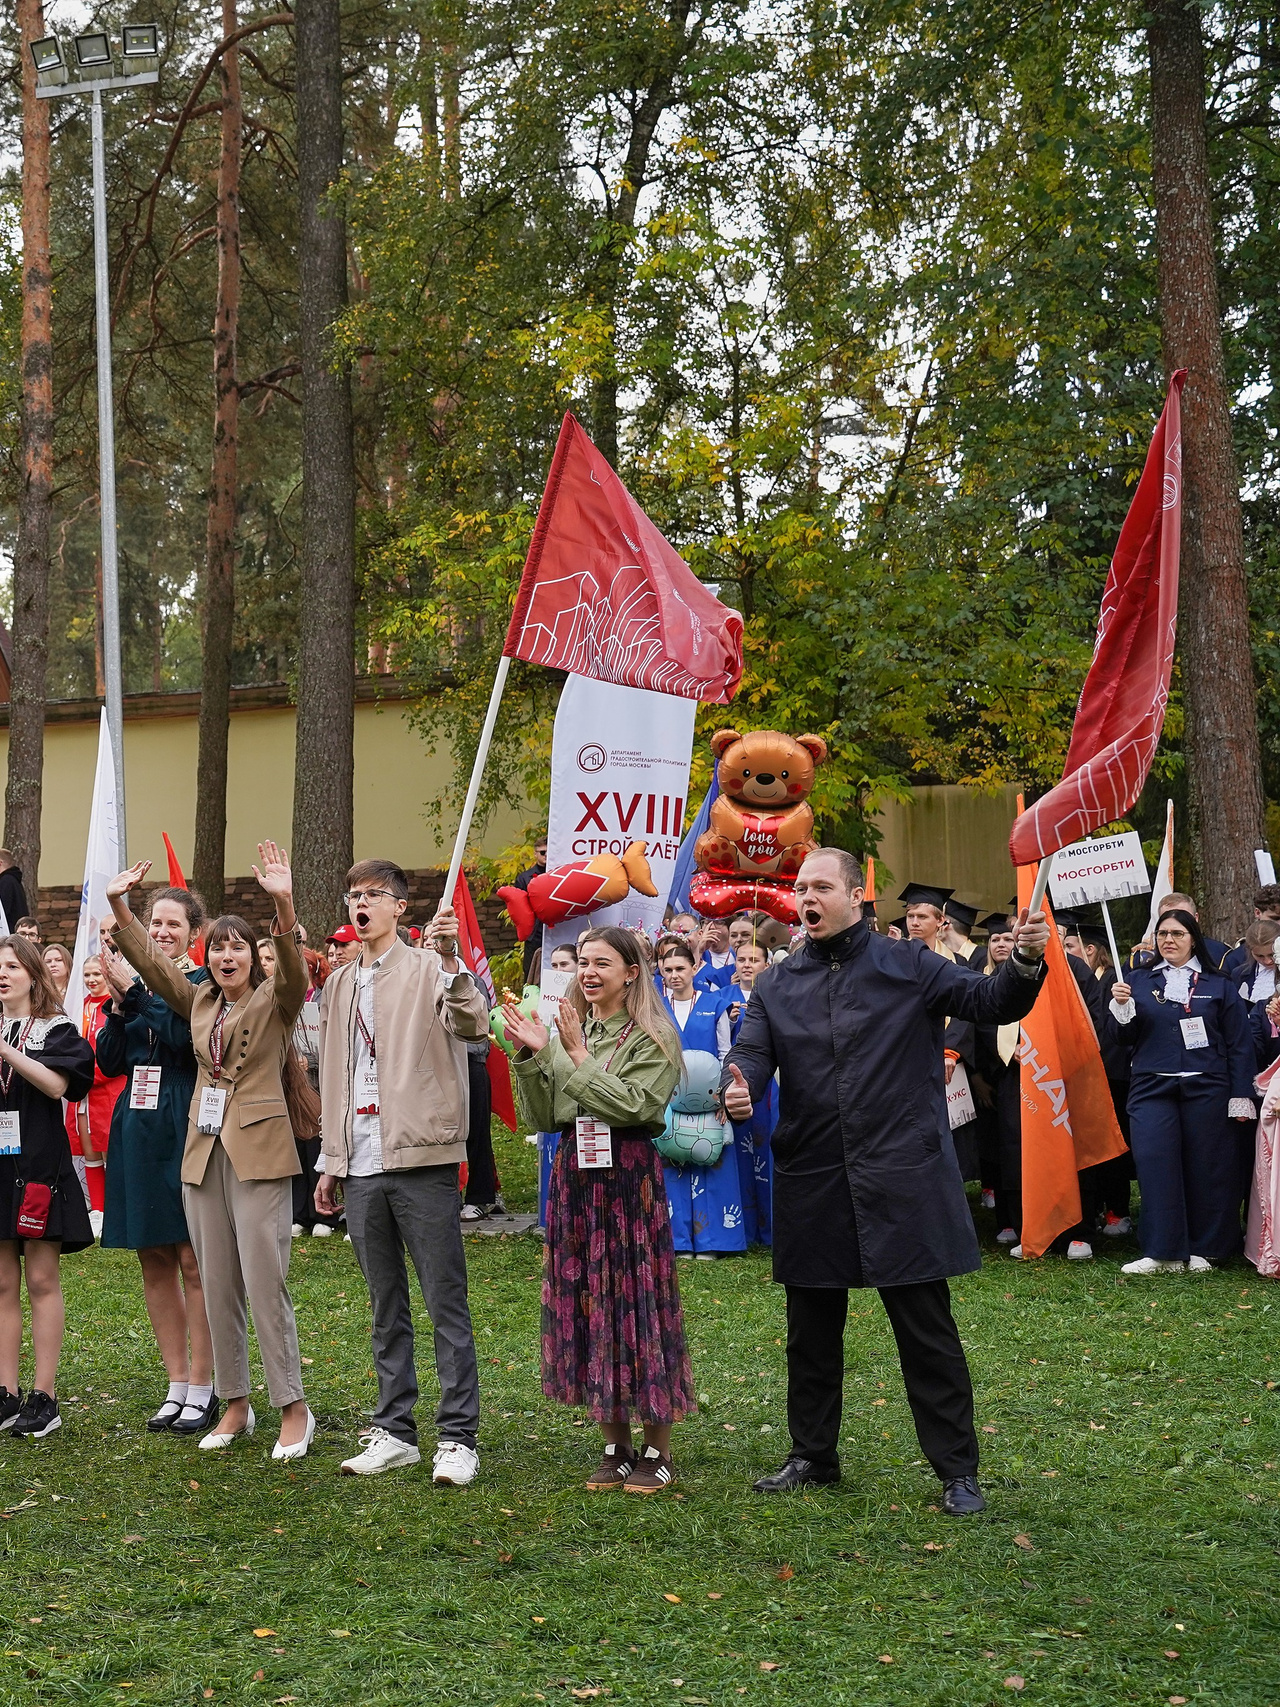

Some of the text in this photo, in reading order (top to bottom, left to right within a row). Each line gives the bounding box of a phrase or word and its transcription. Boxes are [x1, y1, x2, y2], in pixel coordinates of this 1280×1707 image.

[610, 755, 687, 767] ГРАДОСТРОИТЕЛЬНОЙ ПОЛИТИКИ
[574, 791, 683, 837] XVIII
[757, 820, 762, 832] I
[743, 827, 777, 845] love
[571, 836, 680, 861] СТРОЙЛЁТ
[747, 844, 778, 858] you
[1068, 840, 1125, 857] МОСГОРБТИ
[1057, 859, 1135, 882] МОСГОРБТИ
